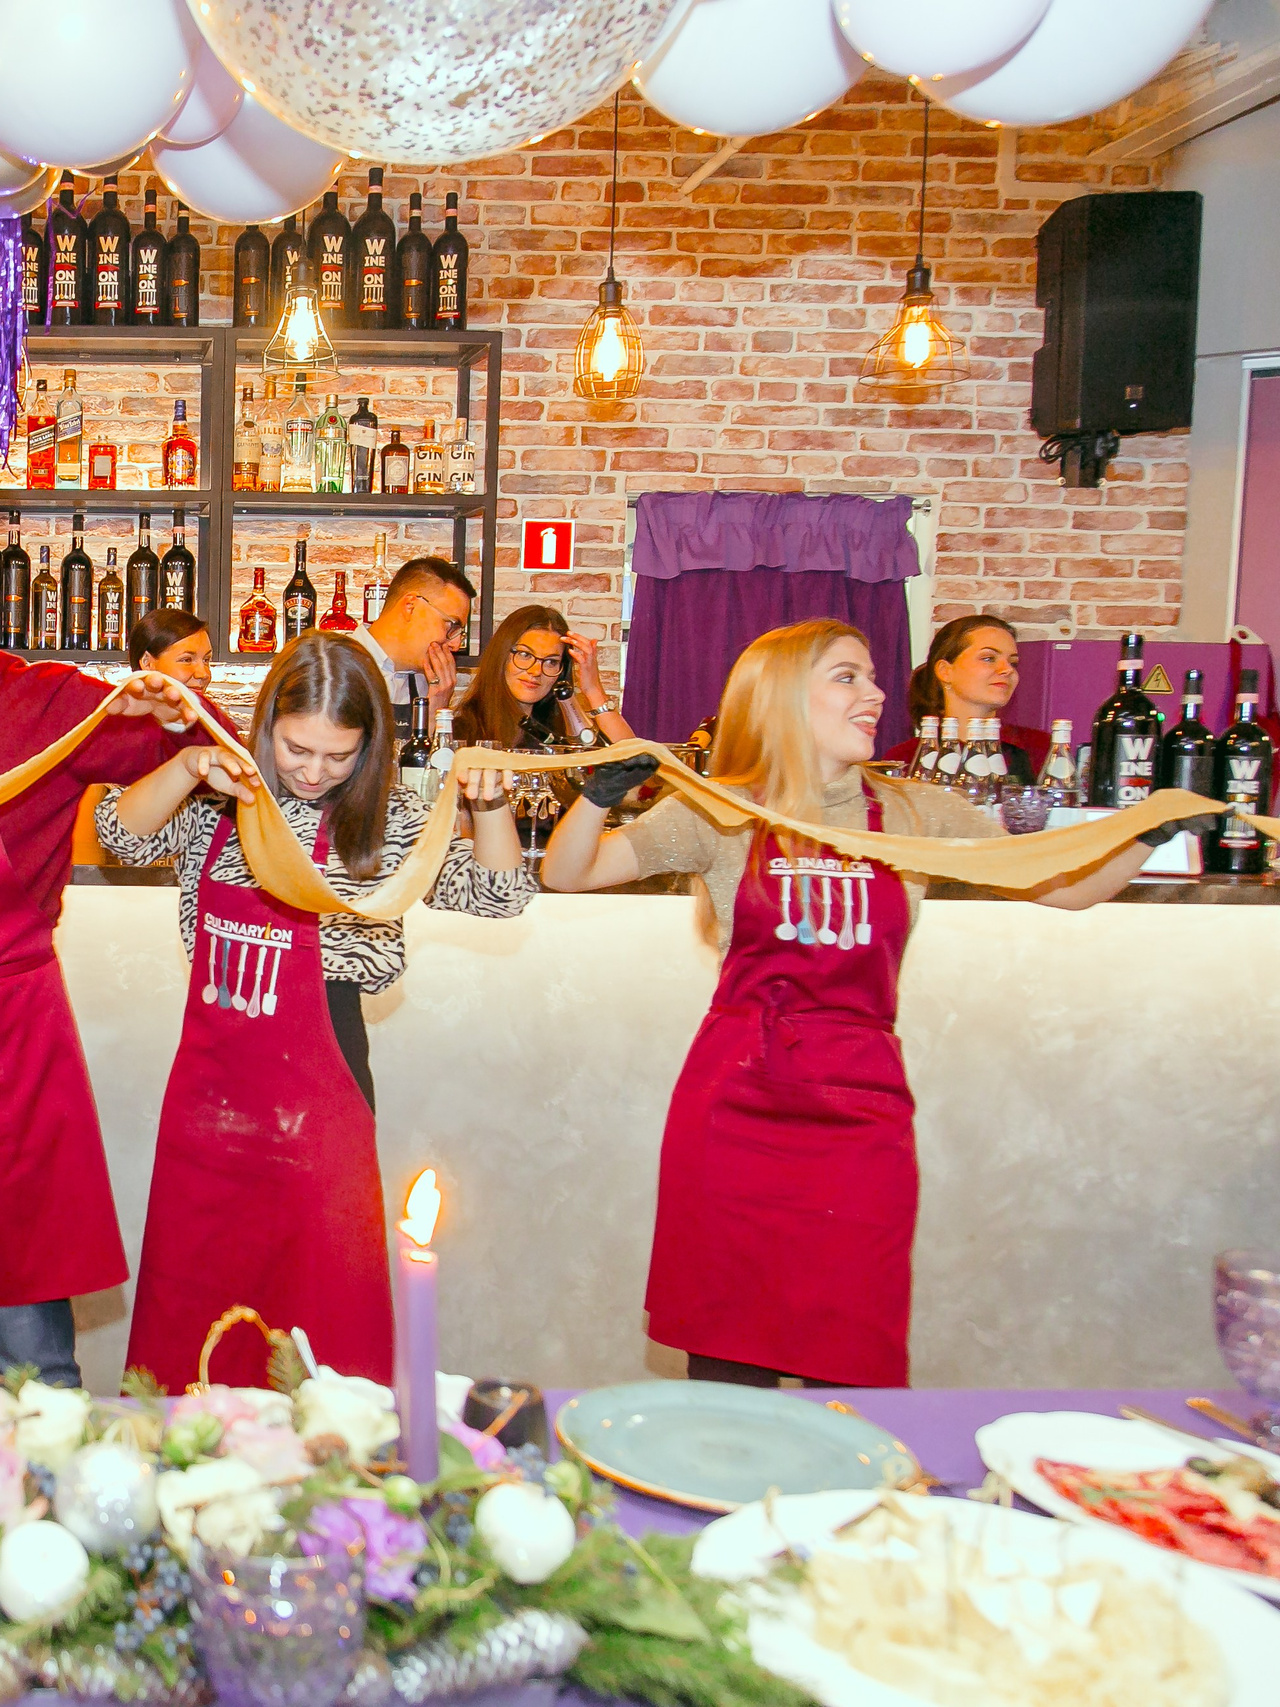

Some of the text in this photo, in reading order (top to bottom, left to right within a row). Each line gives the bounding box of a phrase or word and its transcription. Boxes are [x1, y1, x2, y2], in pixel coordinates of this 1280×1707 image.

[56, 234, 77, 251] W
[99, 236, 119, 253] W
[323, 235, 343, 252] W
[365, 238, 386, 255] W
[55, 252, 77, 263] INE
[98, 253, 120, 265] INE
[139, 249, 157, 264] W
[322, 253, 343, 264] INE
[364, 256, 385, 267] INE
[440, 253, 458, 269] W
[139, 264, 157, 274] INE
[439, 269, 458, 279] INE
[55, 270, 75, 281] ON
[98, 270, 118, 282] ON
[322, 271, 341, 282] ON
[363, 273, 383, 285] ON
[138, 279, 156, 289] ON
[439, 284, 456, 294] ON
[166, 571, 184, 587] W
[106, 592, 120, 603] W
[165, 587, 184, 596] INE
[105, 602, 120, 610] INE
[1122, 737, 1154, 761] W
[1119, 761, 1153, 776] INE
[1229, 759, 1261, 780] W
[1117, 785, 1150, 801] ON
[1226, 780, 1260, 794] INE
